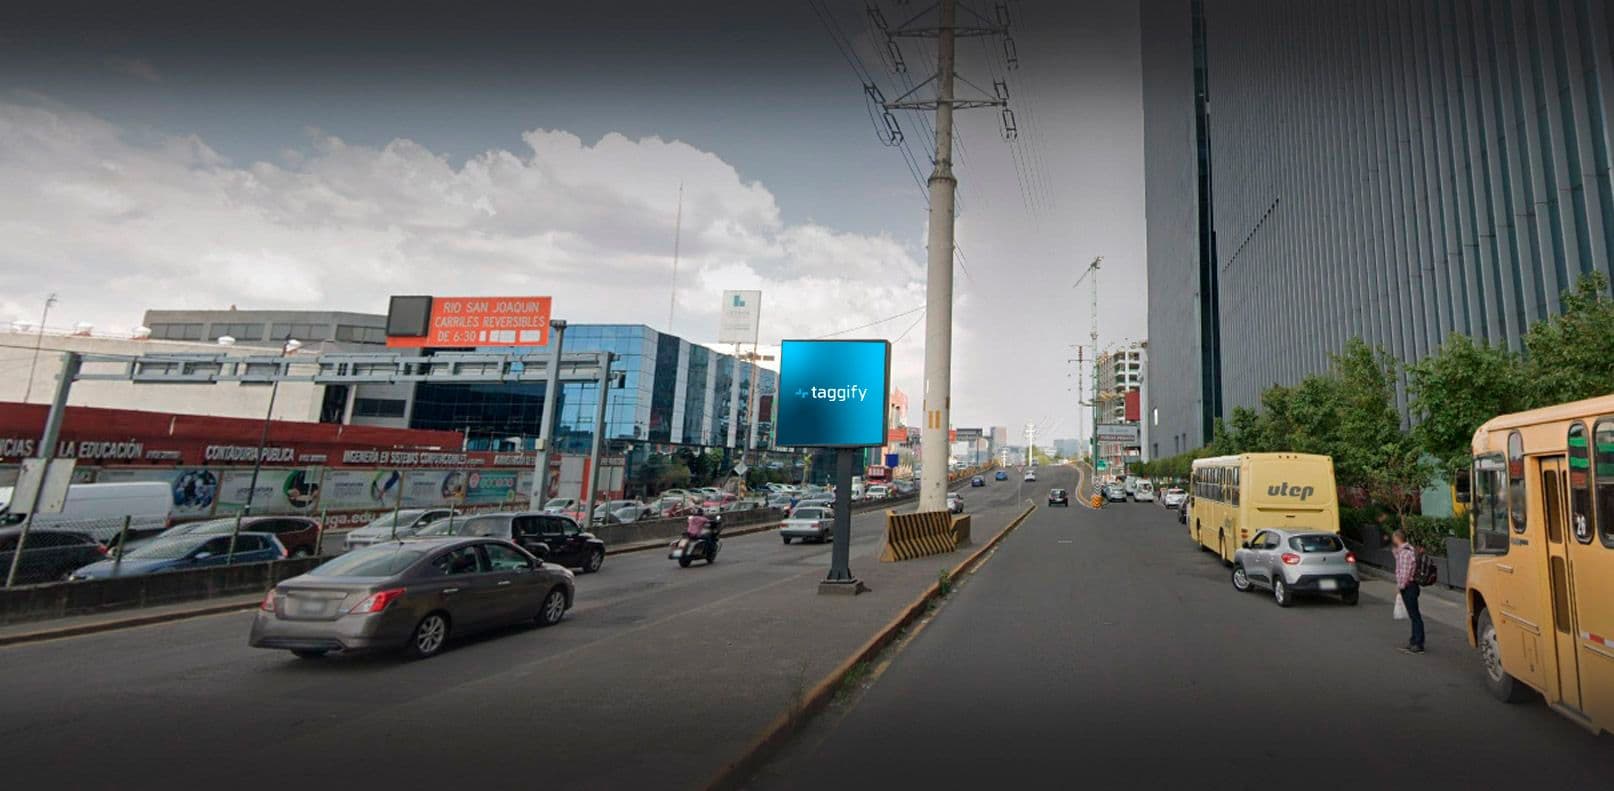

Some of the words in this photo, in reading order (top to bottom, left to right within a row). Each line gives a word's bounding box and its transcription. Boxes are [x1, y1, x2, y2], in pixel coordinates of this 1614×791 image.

[466, 302, 488, 313] SAN
[434, 317, 479, 328] CARRILES
[482, 316, 545, 328] REVERSIBLES
[437, 331, 449, 342] DE
[811, 385, 868, 402] taggify
[58, 440, 76, 457] LA
[79, 438, 143, 458] EDUCACIÓN
[1267, 482, 1314, 501] utep
